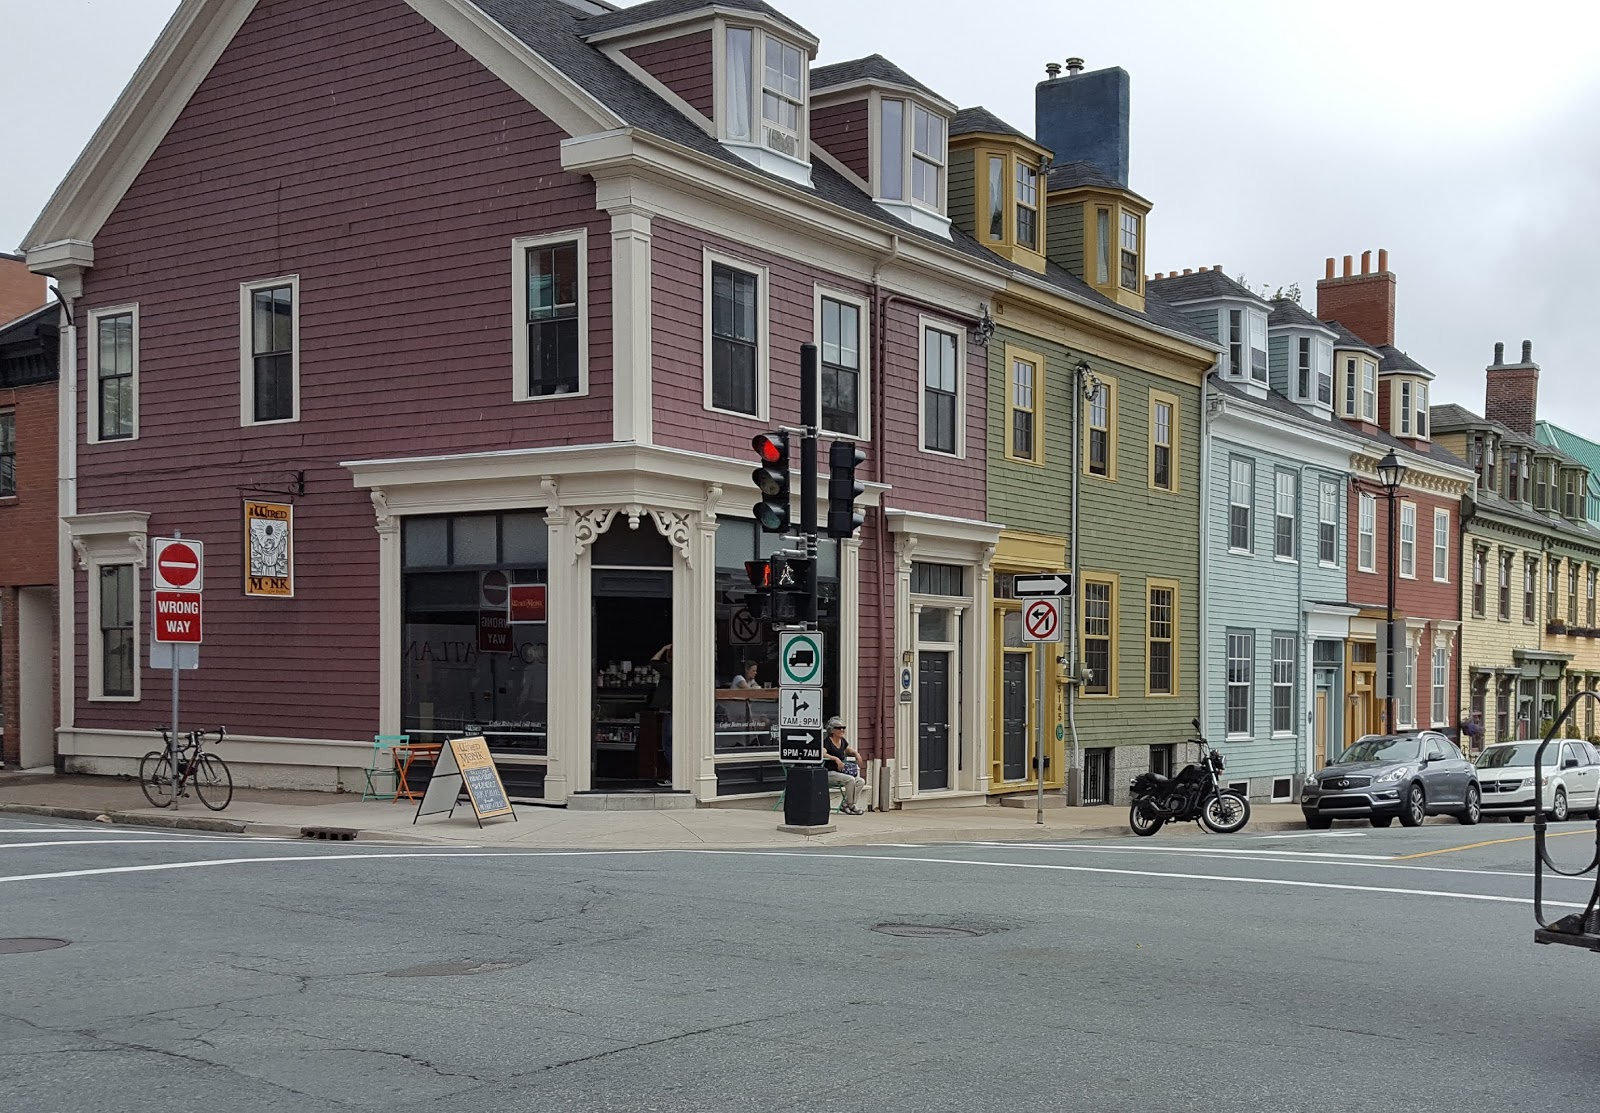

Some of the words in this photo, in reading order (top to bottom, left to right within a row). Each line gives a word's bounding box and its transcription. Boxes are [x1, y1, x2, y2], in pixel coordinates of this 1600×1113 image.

[158, 601, 199, 614] WRONG
[166, 621, 191, 633] WAY
[783, 717, 798, 725] 7AM
[803, 749, 819, 757] 7AM
